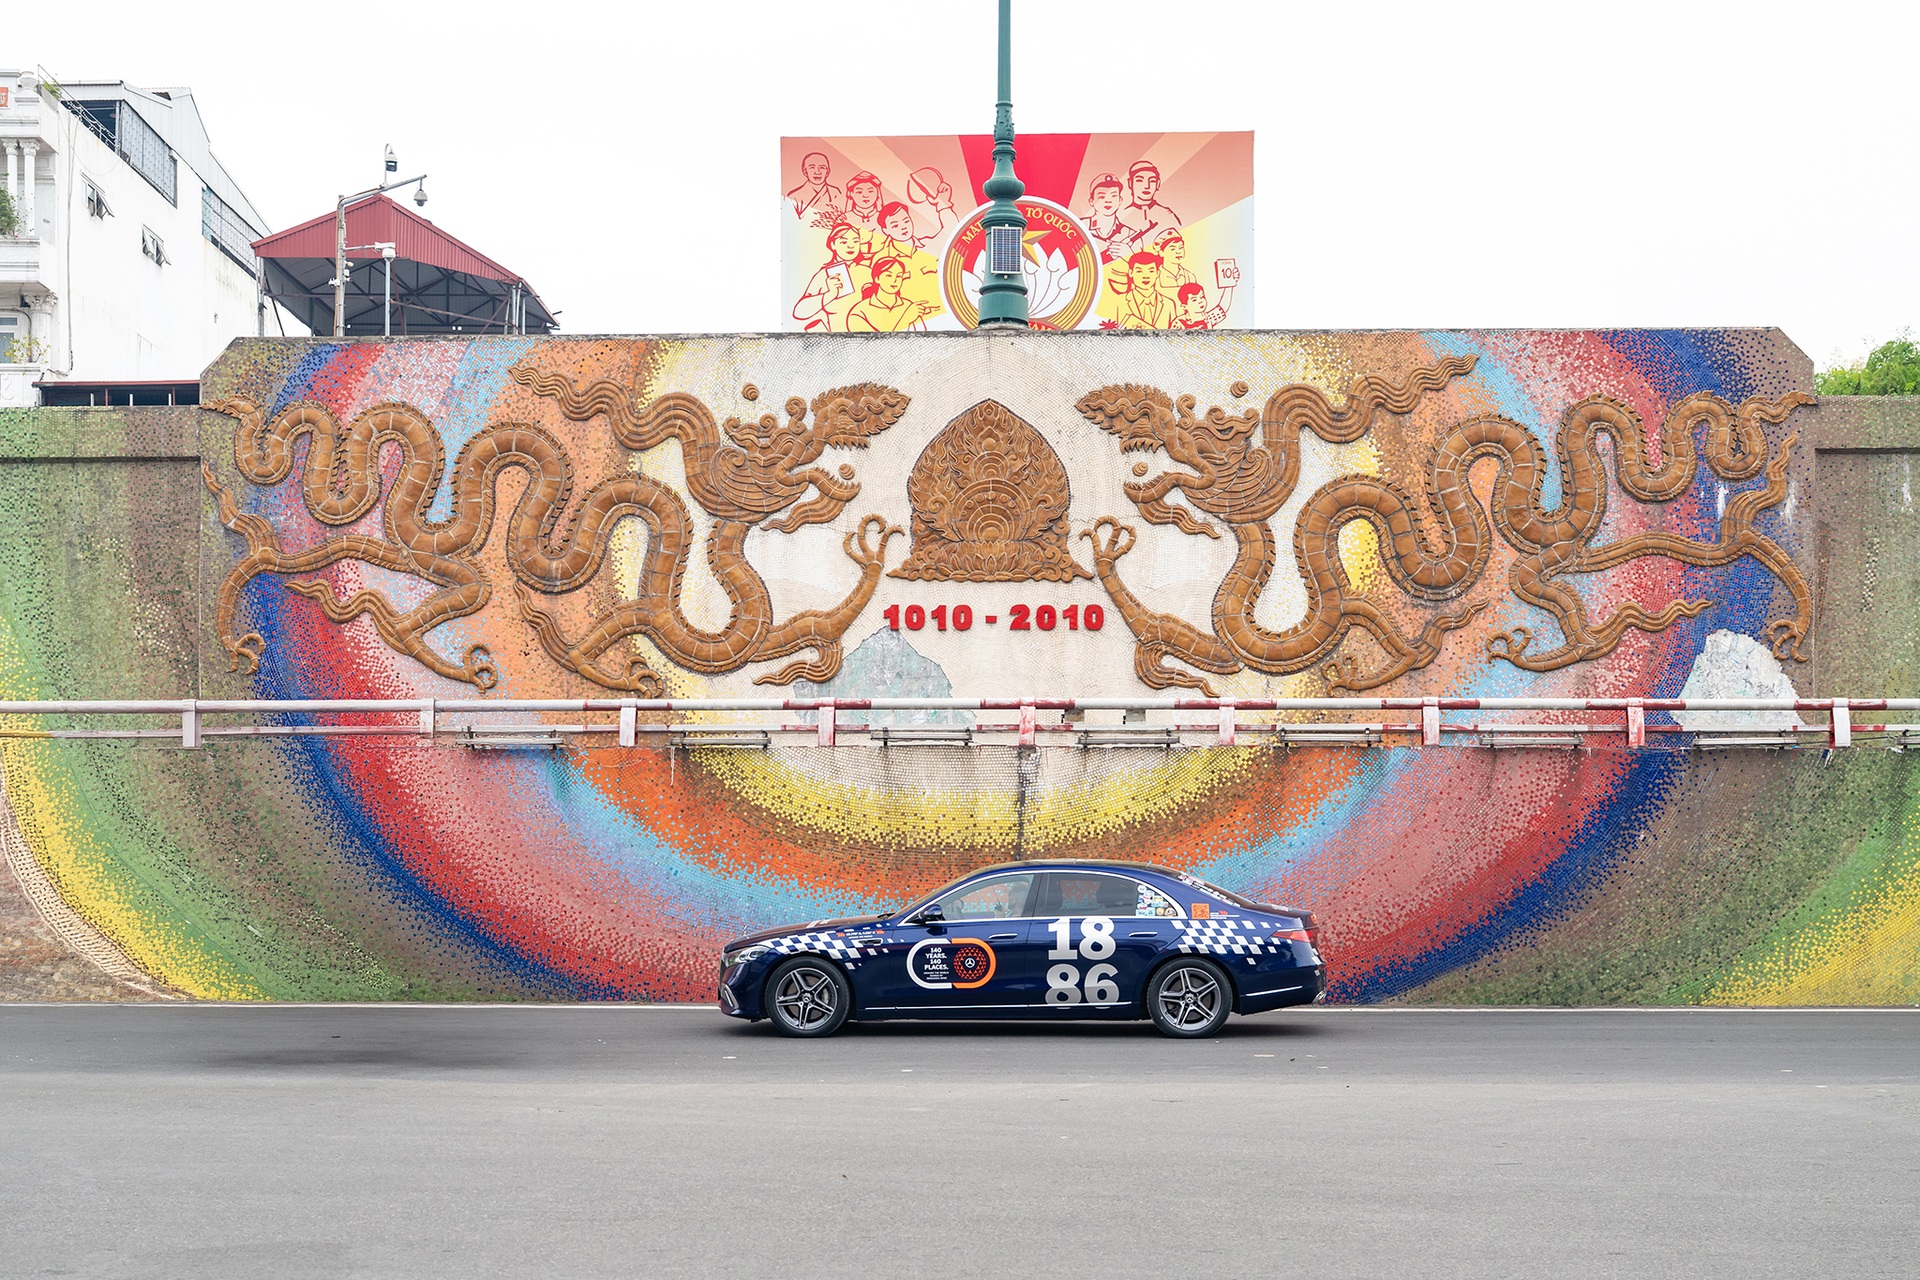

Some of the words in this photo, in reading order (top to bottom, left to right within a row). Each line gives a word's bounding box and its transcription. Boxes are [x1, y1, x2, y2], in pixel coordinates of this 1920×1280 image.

[1043, 212, 1077, 239] QUỐC
[1221, 267, 1232, 279] 10
[883, 604, 973, 631] 1010
[985, 615, 997, 623] -
[1009, 604, 1104, 631] 2010
[1048, 917, 1116, 960] 18
[1045, 963, 1119, 1009] 86
